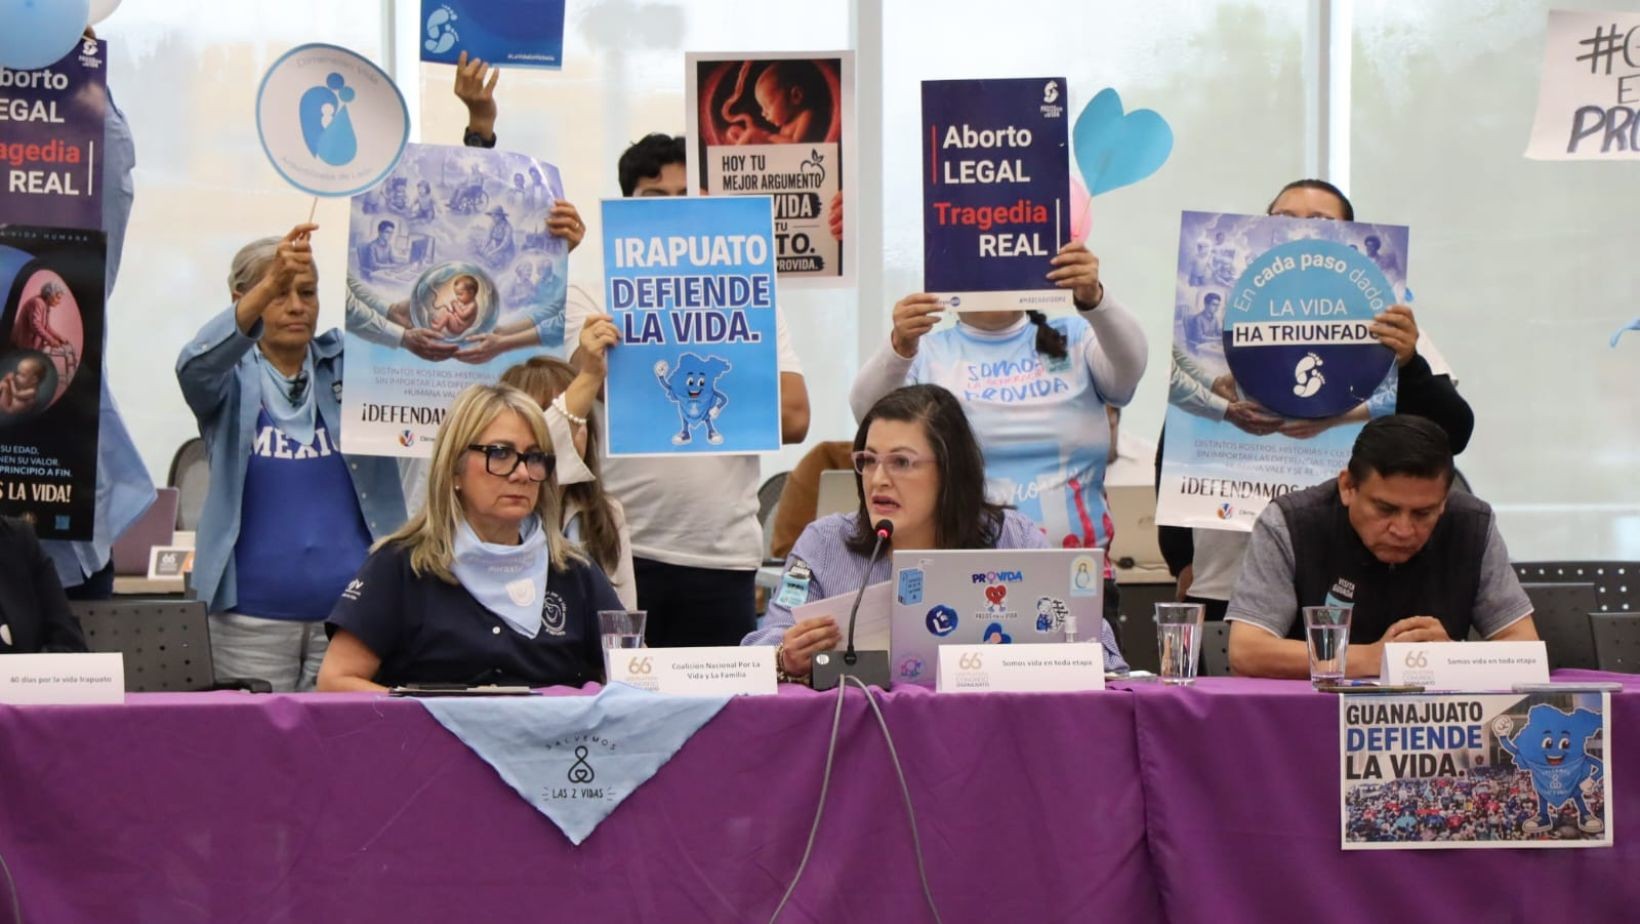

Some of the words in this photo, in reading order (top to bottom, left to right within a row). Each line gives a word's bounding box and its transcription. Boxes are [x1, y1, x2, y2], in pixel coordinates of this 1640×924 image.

[0, 67, 69, 90] borto
[1617, 74, 1640, 105] E
[0, 98, 65, 123] EGAL
[942, 124, 1032, 149] Aborto
[0, 138, 81, 166] agedia
[722, 155, 746, 172] HOY
[750, 154, 766, 171] TU
[8, 170, 80, 196] REAL
[722, 174, 758, 191] MEJOR
[760, 173, 821, 190] ARGUMENTO
[944, 160, 1031, 184] LEGAL
[933, 199, 1048, 230] Tragedia
[615, 234, 768, 268] IRAPUATO
[775, 232, 816, 254] TO.
[979, 233, 1049, 257] REAL
[610, 274, 771, 310] DEFIENDE
[1233, 287, 1257, 313] En
[1253, 255, 1296, 288] cada
[1300, 252, 1347, 274] paso
[1348, 267, 1384, 312] dado
[1269, 300, 1295, 317] LA
[1300, 299, 1348, 316] VIDA
[624, 311, 665, 344] LA
[671, 310, 761, 344] VIDA.
[1235, 324, 1264, 343] HA
[1, 446, 12, 454] SU
[18, 457, 29, 465] SU
[46, 468, 54, 476] A
[8, 482, 26, 501] LA
[32, 484, 73, 503] VIDA!
[705, 661, 737, 670] Nacional
[738, 661, 750, 669] Por
[752, 661, 761, 669] La
[1002, 659, 1026, 667] Somos
[1026, 659, 1042, 667] vida
[1072, 660, 1093, 668] etapa
[1447, 657, 1470, 665] Somos
[1471, 657, 1487, 665] vida
[1498, 657, 1515, 665] toda
[1516, 658, 1536, 666] etapa
[38, 676, 51, 685] por
[52, 675, 60, 683] la
[62, 675, 78, 683] vida
[79, 675, 113, 685] Irapuato
[687, 672, 704, 680] Vida
[711, 672, 719, 680] La
[720, 671, 747, 680] Familia
[1345, 701, 1484, 726] GUANAJUATO
[1345, 725, 1484, 753] DEFIENDE
[1345, 755, 1383, 781] LA
[1389, 752, 1467, 780] VIDA.
[552, 788, 568, 799] LAS
[571, 788, 577, 799] 2
[581, 788, 604, 799] VIDAS
